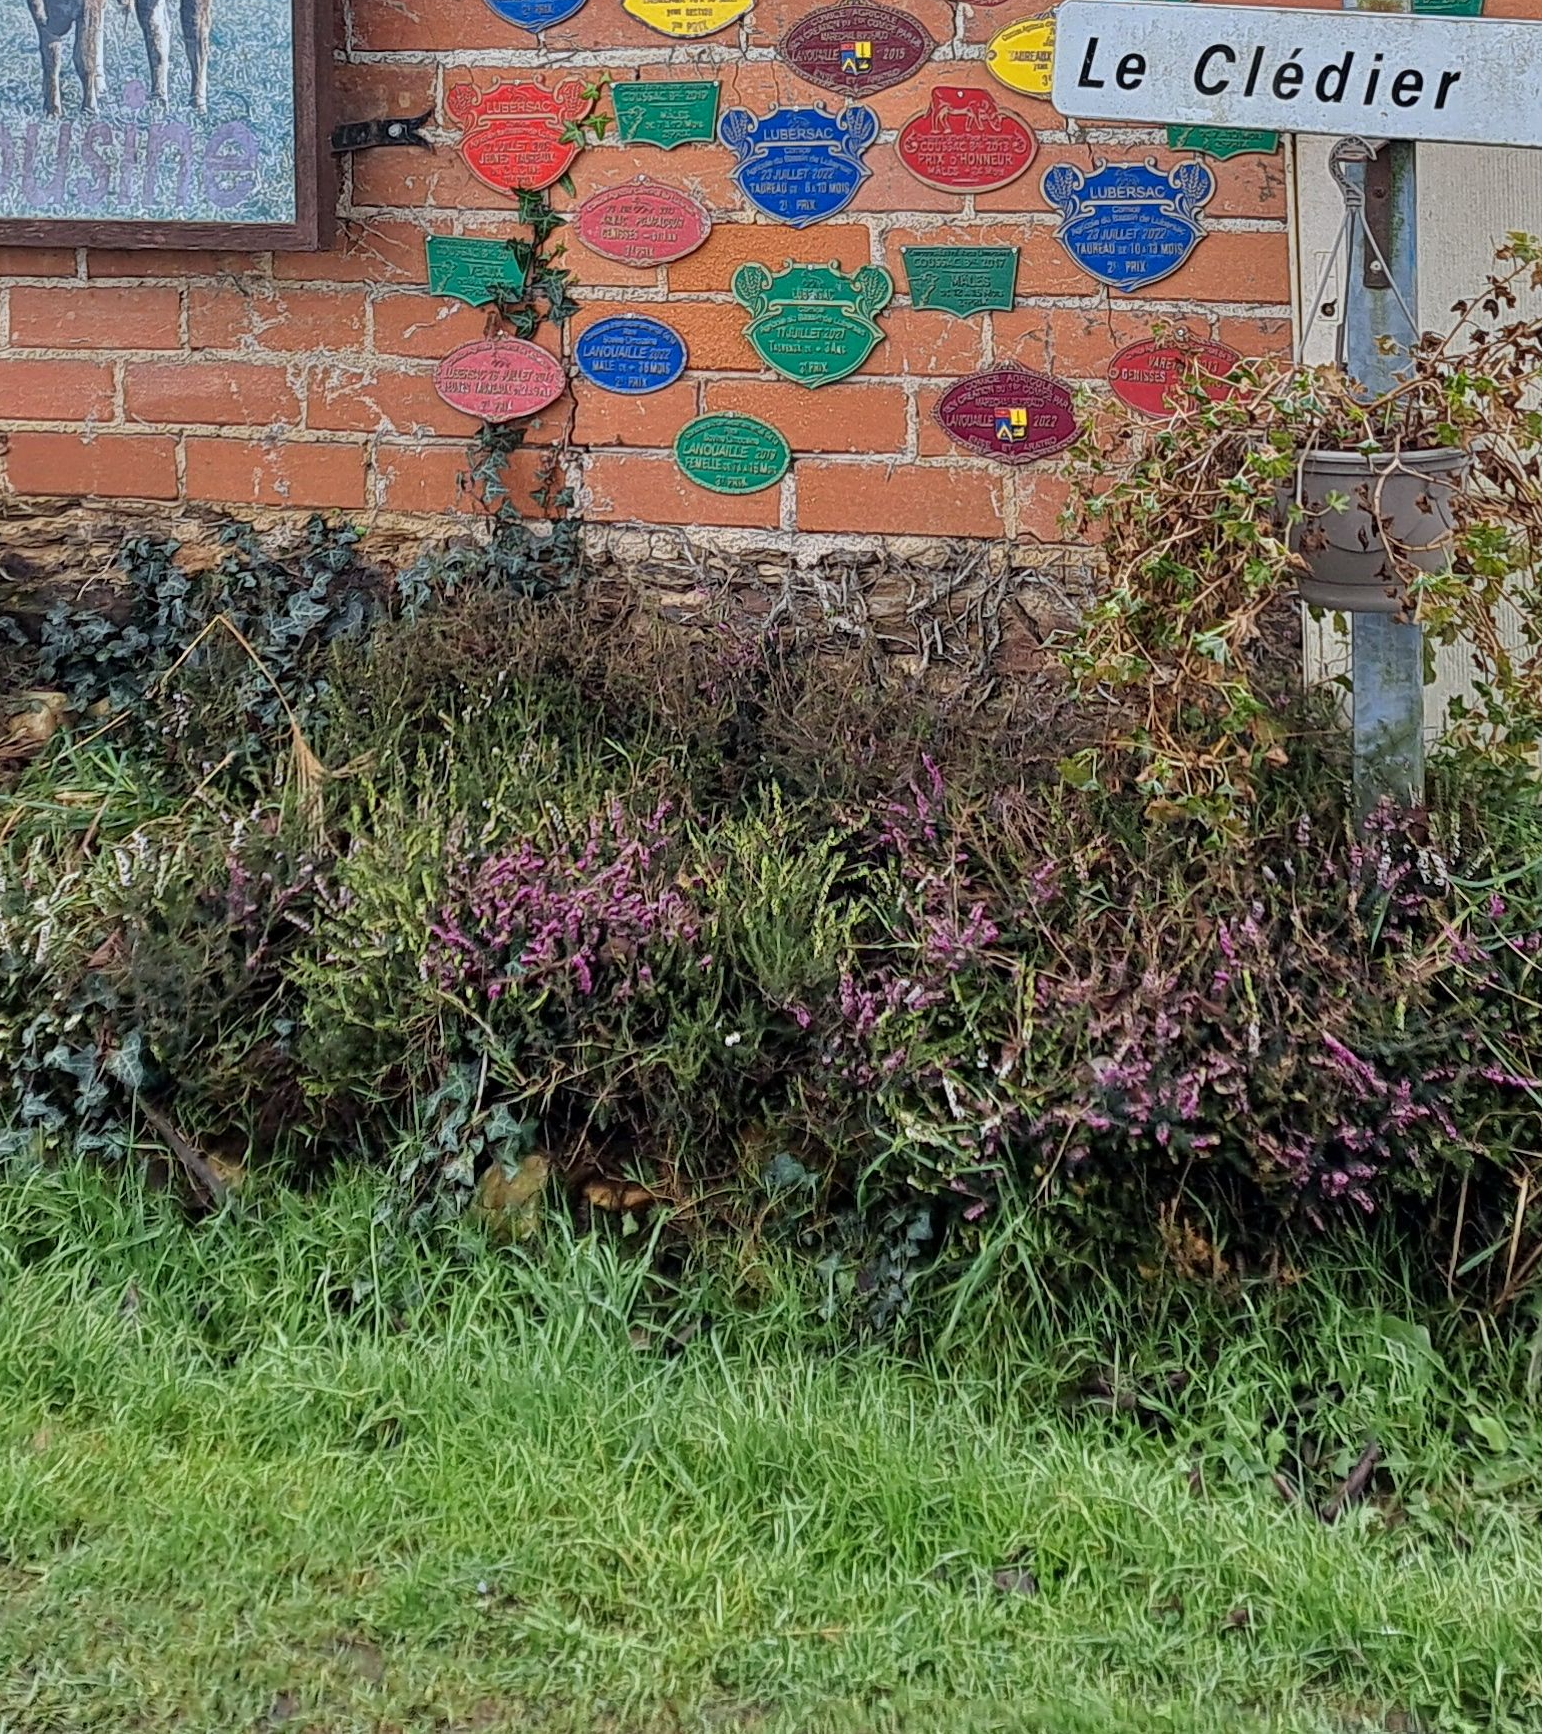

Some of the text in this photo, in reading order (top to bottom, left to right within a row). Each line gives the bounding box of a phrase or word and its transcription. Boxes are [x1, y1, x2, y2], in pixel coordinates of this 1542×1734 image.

[883, 48, 905, 59] 2015
[1077, 36, 1461, 111] Le Clédier
[486, 101, 552, 114] LUBERSAC
[763, 128, 833, 140] LUBERSAC
[920, 142, 967, 152] COUSSAC
[919, 154, 944, 165] PRIX
[761, 168, 834, 180] 23 JUILLET 2022
[750, 183, 850, 194] TAUREAU MOIS
[1090, 186, 1165, 199] LUBERSAC
[796, 200, 816, 210] PRIX
[1087, 228, 1166, 240] 23 JUILLET 2022
[1076, 243, 1115, 254] TAUREAU
[1161, 243, 1183, 255] MOIS
[1125, 262, 1147, 272] PRIX
[583, 346, 648, 358] LANOUAILLE
[592, 360, 615, 371] MALE
[1121, 368, 1166, 383] GENISSES
[1006, 374, 1054, 391] AGRICOLE
[1033, 416, 1058, 427] 2022
[683, 444, 749, 457] LANOUAILLE
